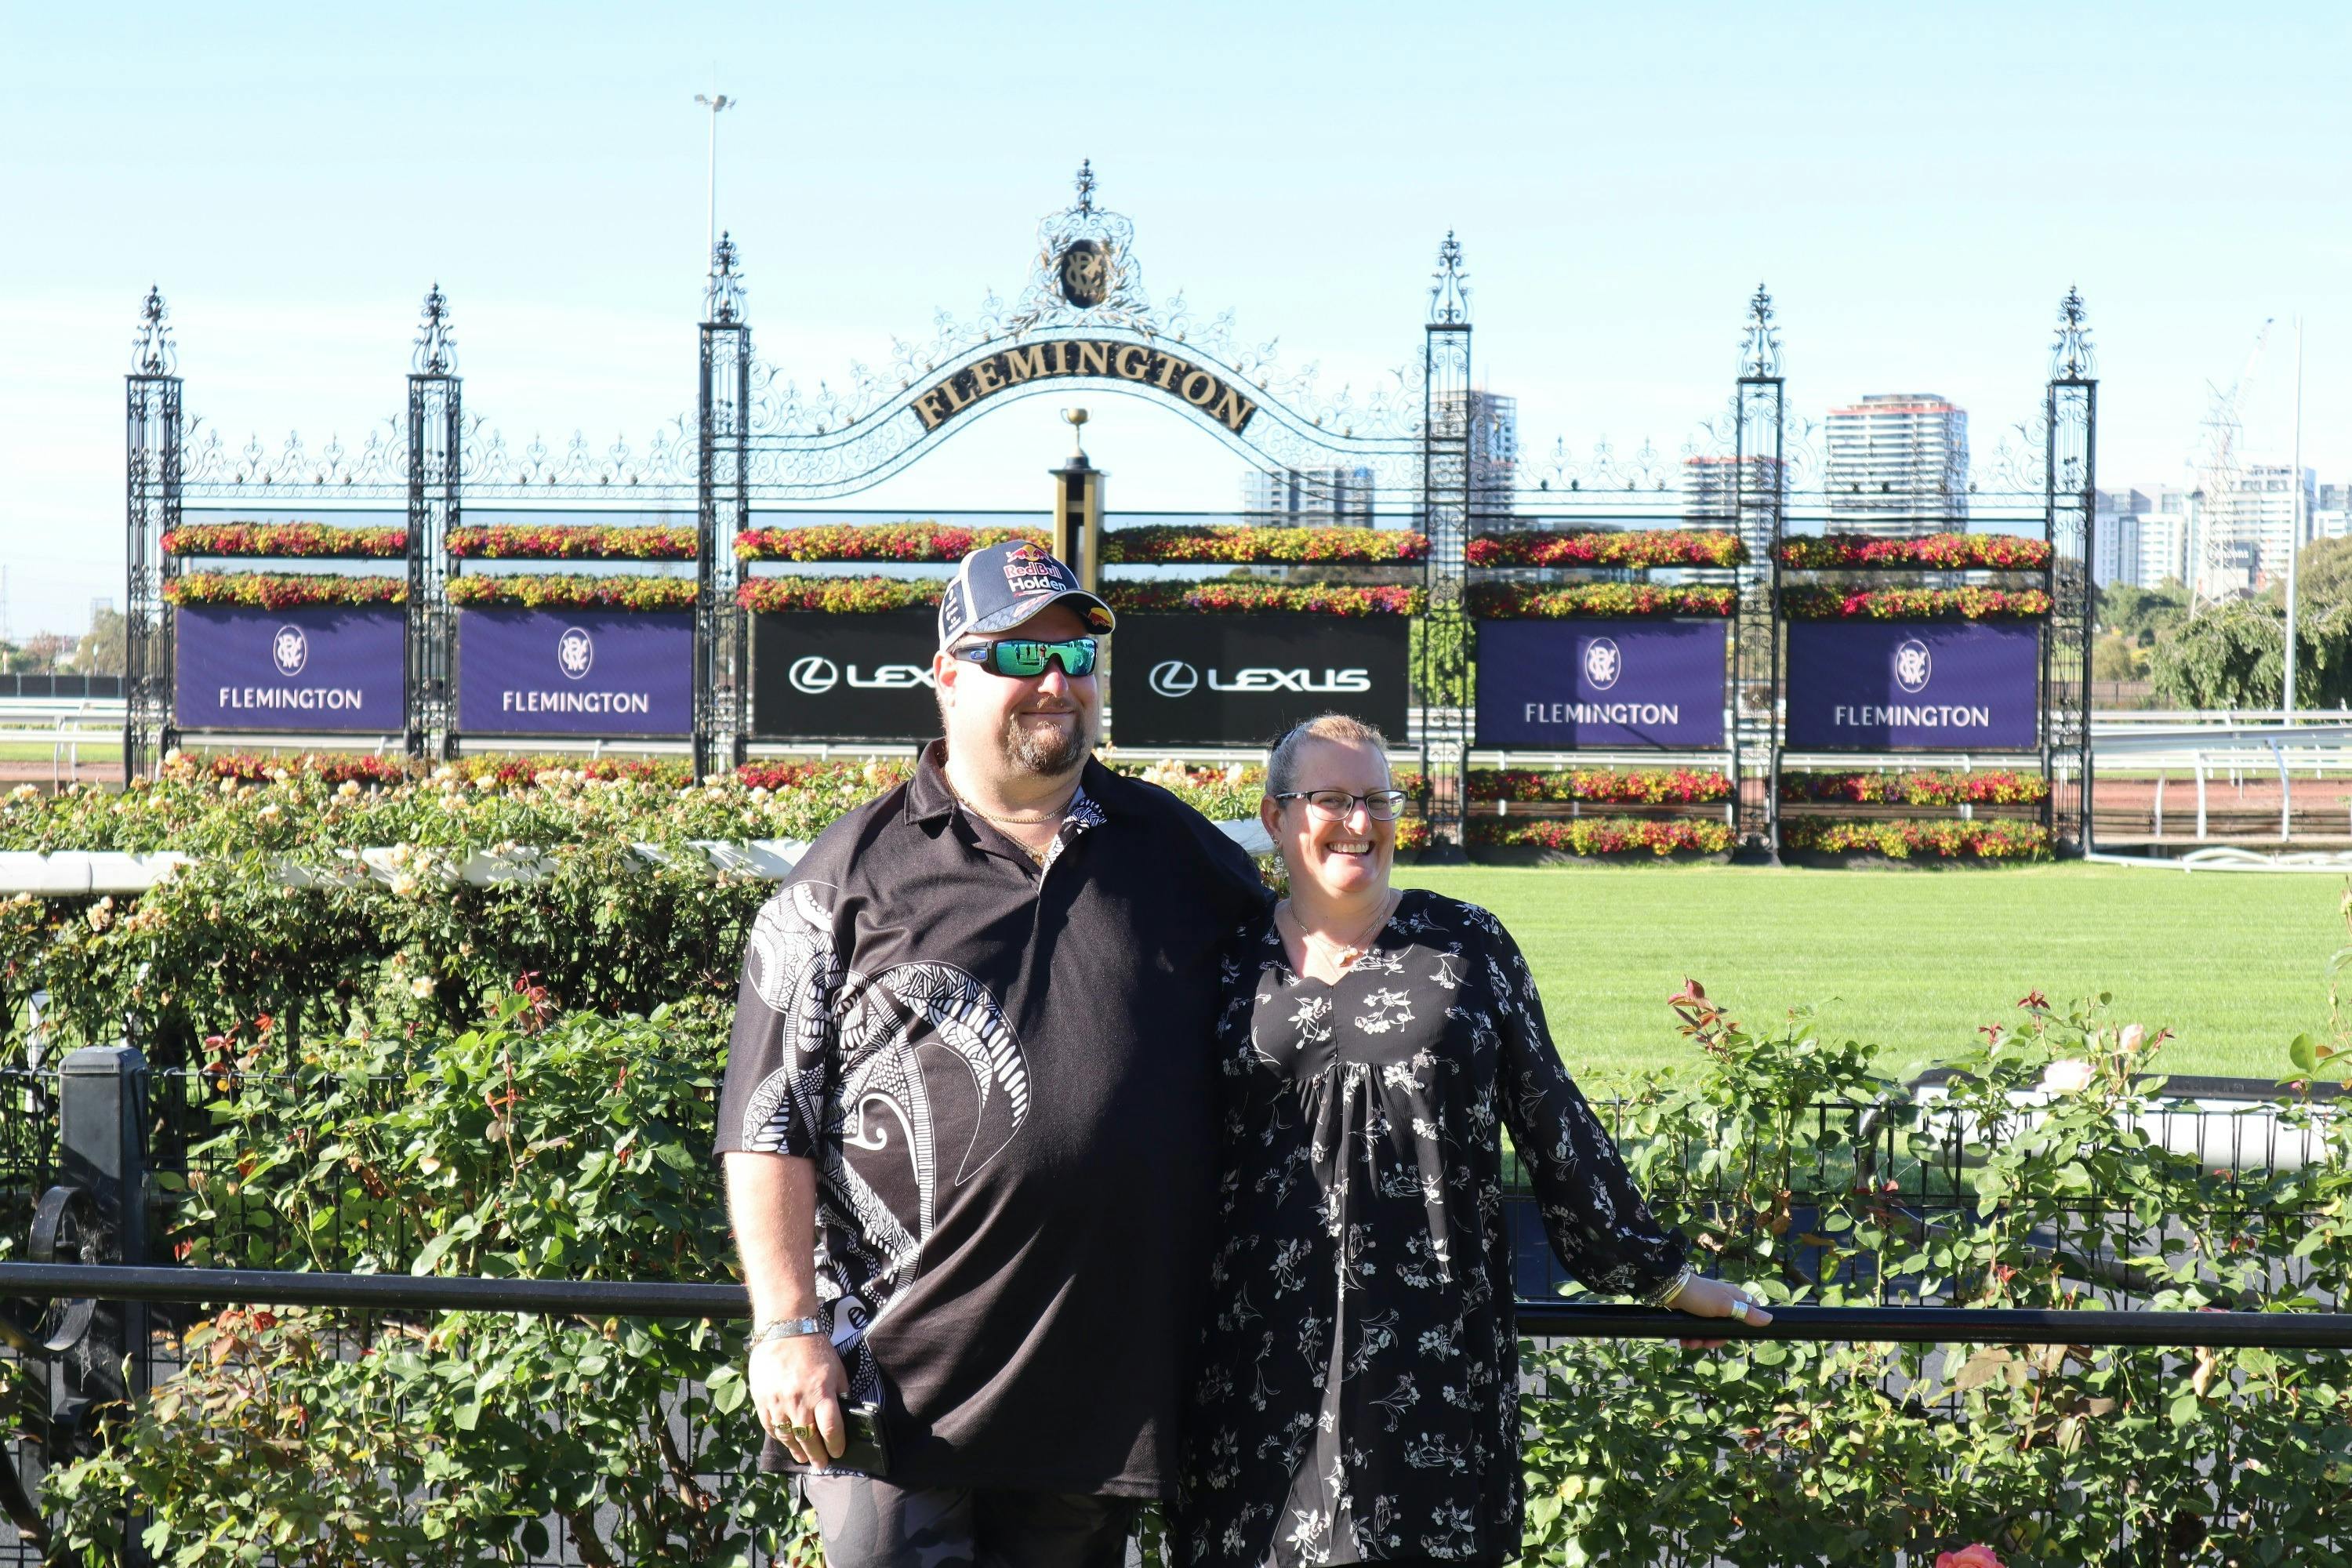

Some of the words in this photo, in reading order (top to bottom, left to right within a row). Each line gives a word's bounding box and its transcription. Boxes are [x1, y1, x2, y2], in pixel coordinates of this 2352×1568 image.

[912, 340, 1257, 430] FLEMINGTON
[1003, 561, 1036, 579] Red
[1036, 562, 1062, 579] Bull
[1007, 576, 1067, 592] Holden
[847, 664, 935, 688] LEX
[1207, 668, 1371, 692] LEXUS
[220, 687, 362, 710] FLEMINGTON
[503, 691, 649, 713] FLEMINGTON
[1526, 703, 1679, 725] FLEMINGTON
[1836, 706, 1990, 728] FLEMINGTON
